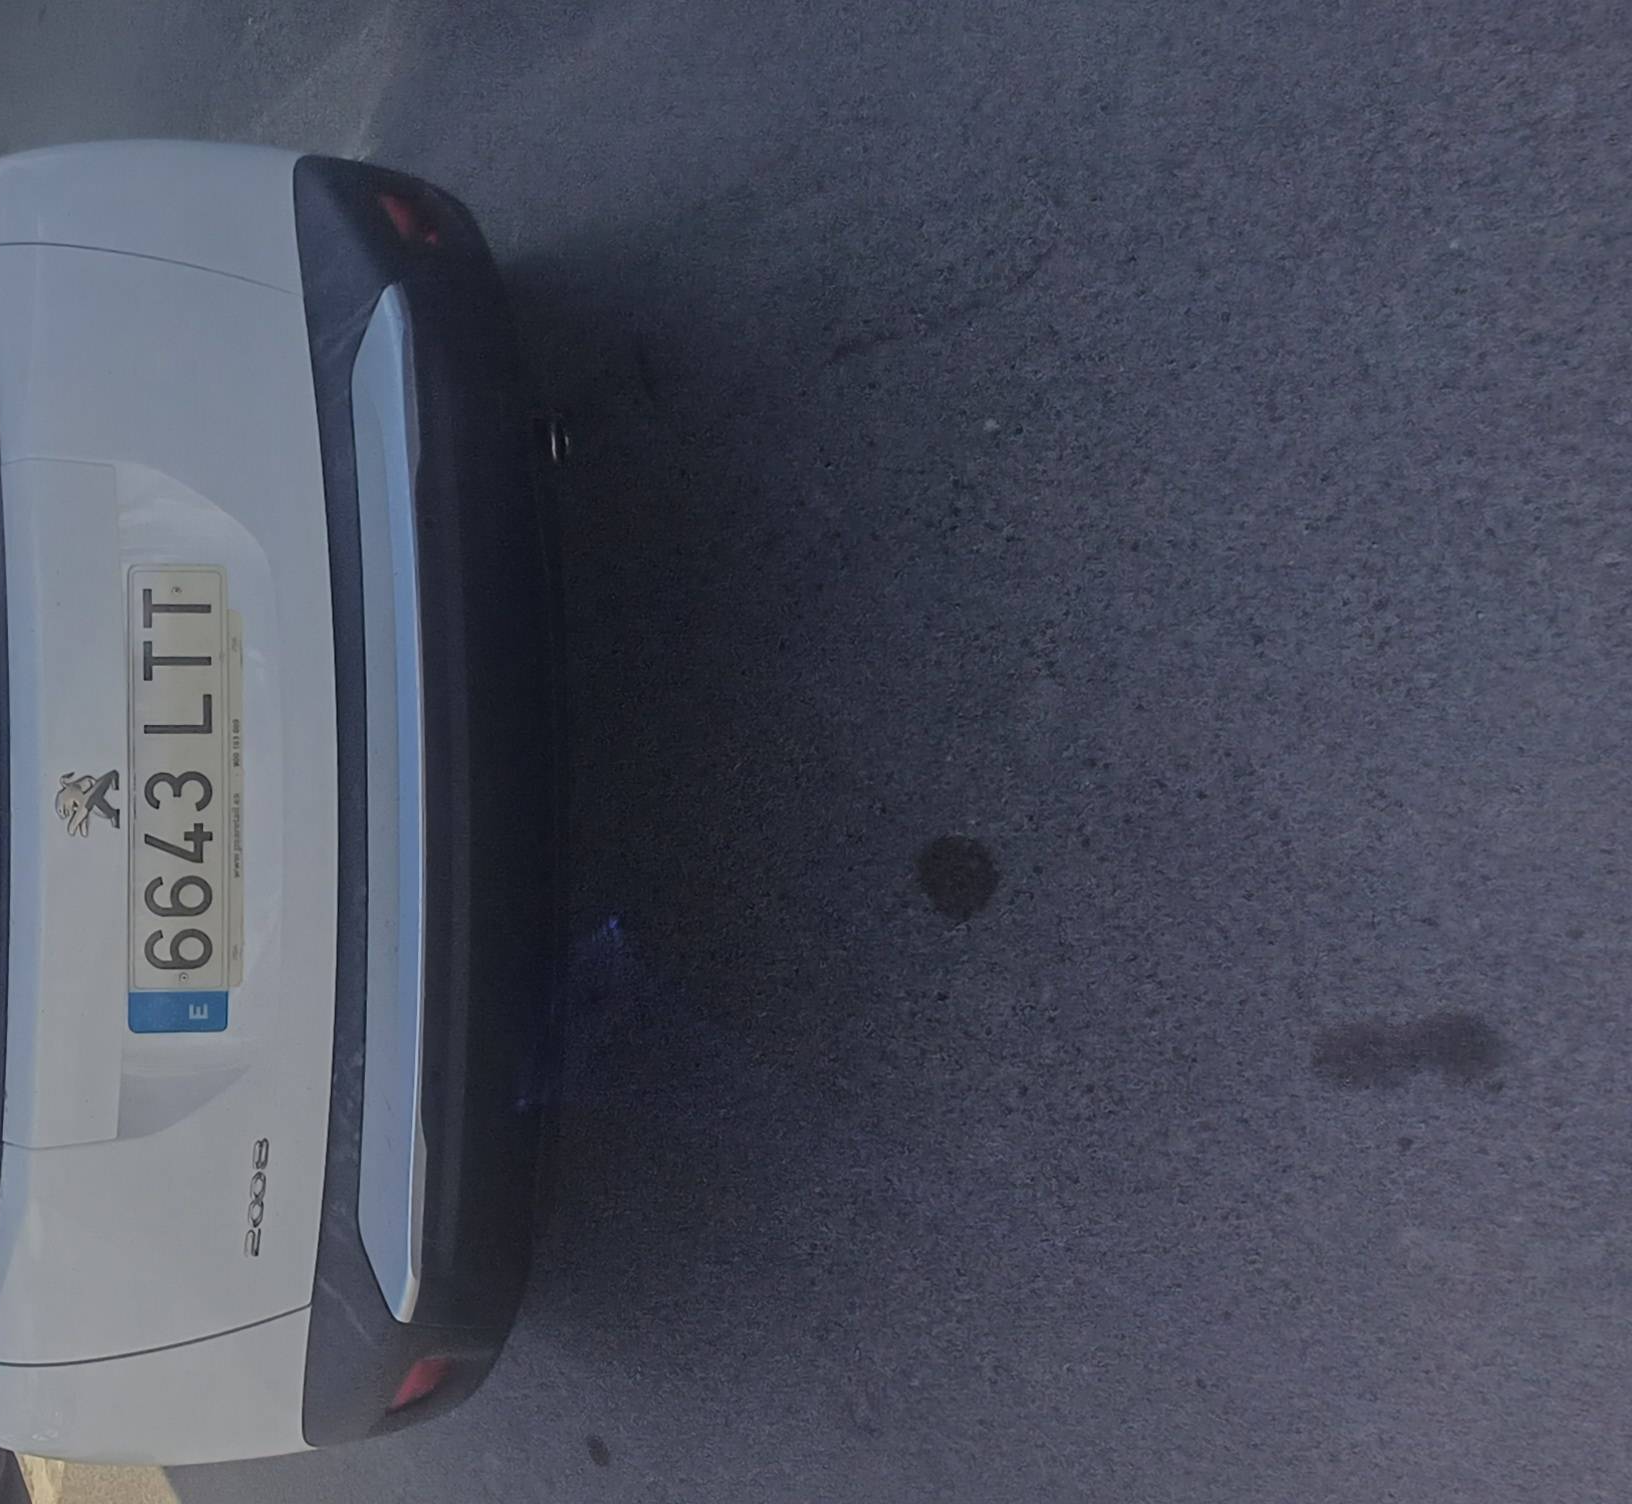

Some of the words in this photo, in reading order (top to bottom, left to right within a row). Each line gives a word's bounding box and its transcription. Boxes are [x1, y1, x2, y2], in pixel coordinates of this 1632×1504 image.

[143, 588, 213, 735] LTT
[143, 771, 213, 970] 6643
[188, 1003, 209, 1020] E
[243, 1137, 269, 1258] 2008
